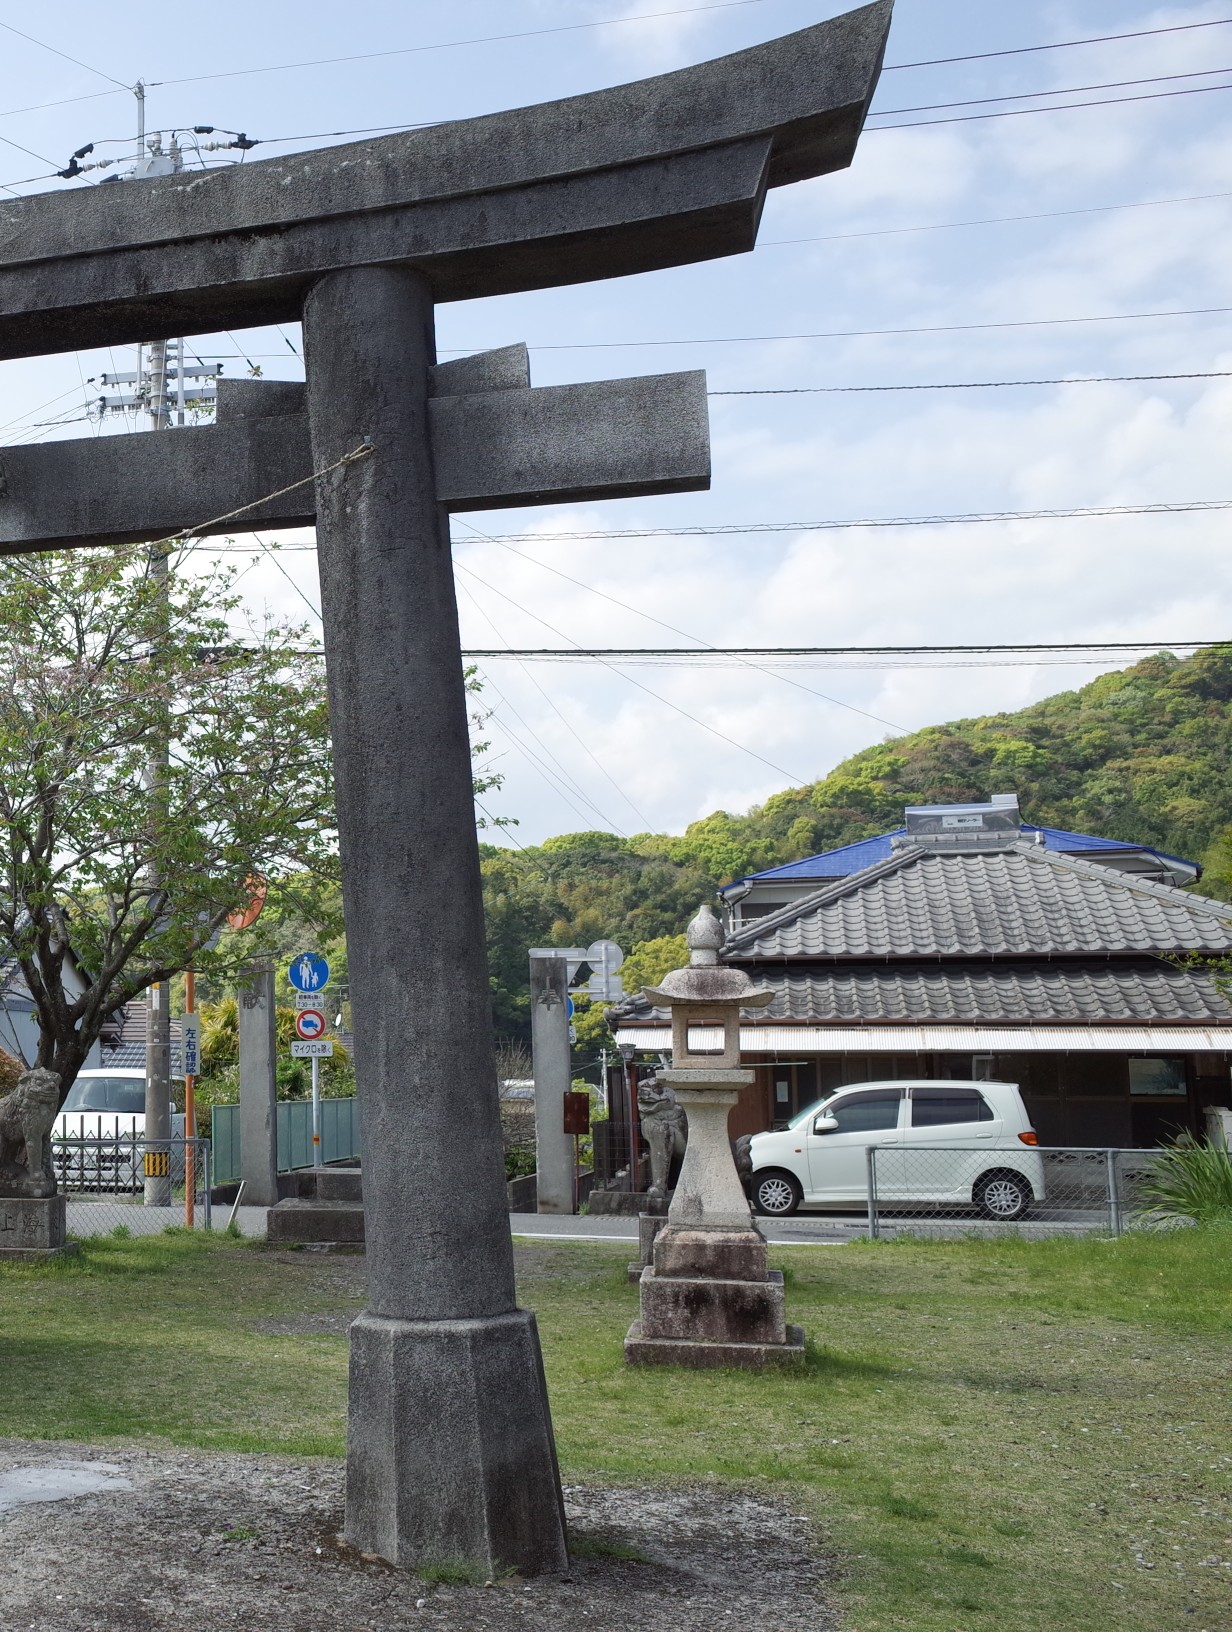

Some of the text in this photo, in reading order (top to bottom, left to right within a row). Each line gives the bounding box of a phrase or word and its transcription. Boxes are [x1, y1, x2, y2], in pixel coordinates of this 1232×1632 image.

[185, 1028, 196, 1073] 左右確認
[293, 1044, 330, 1054] マイクロを除く
